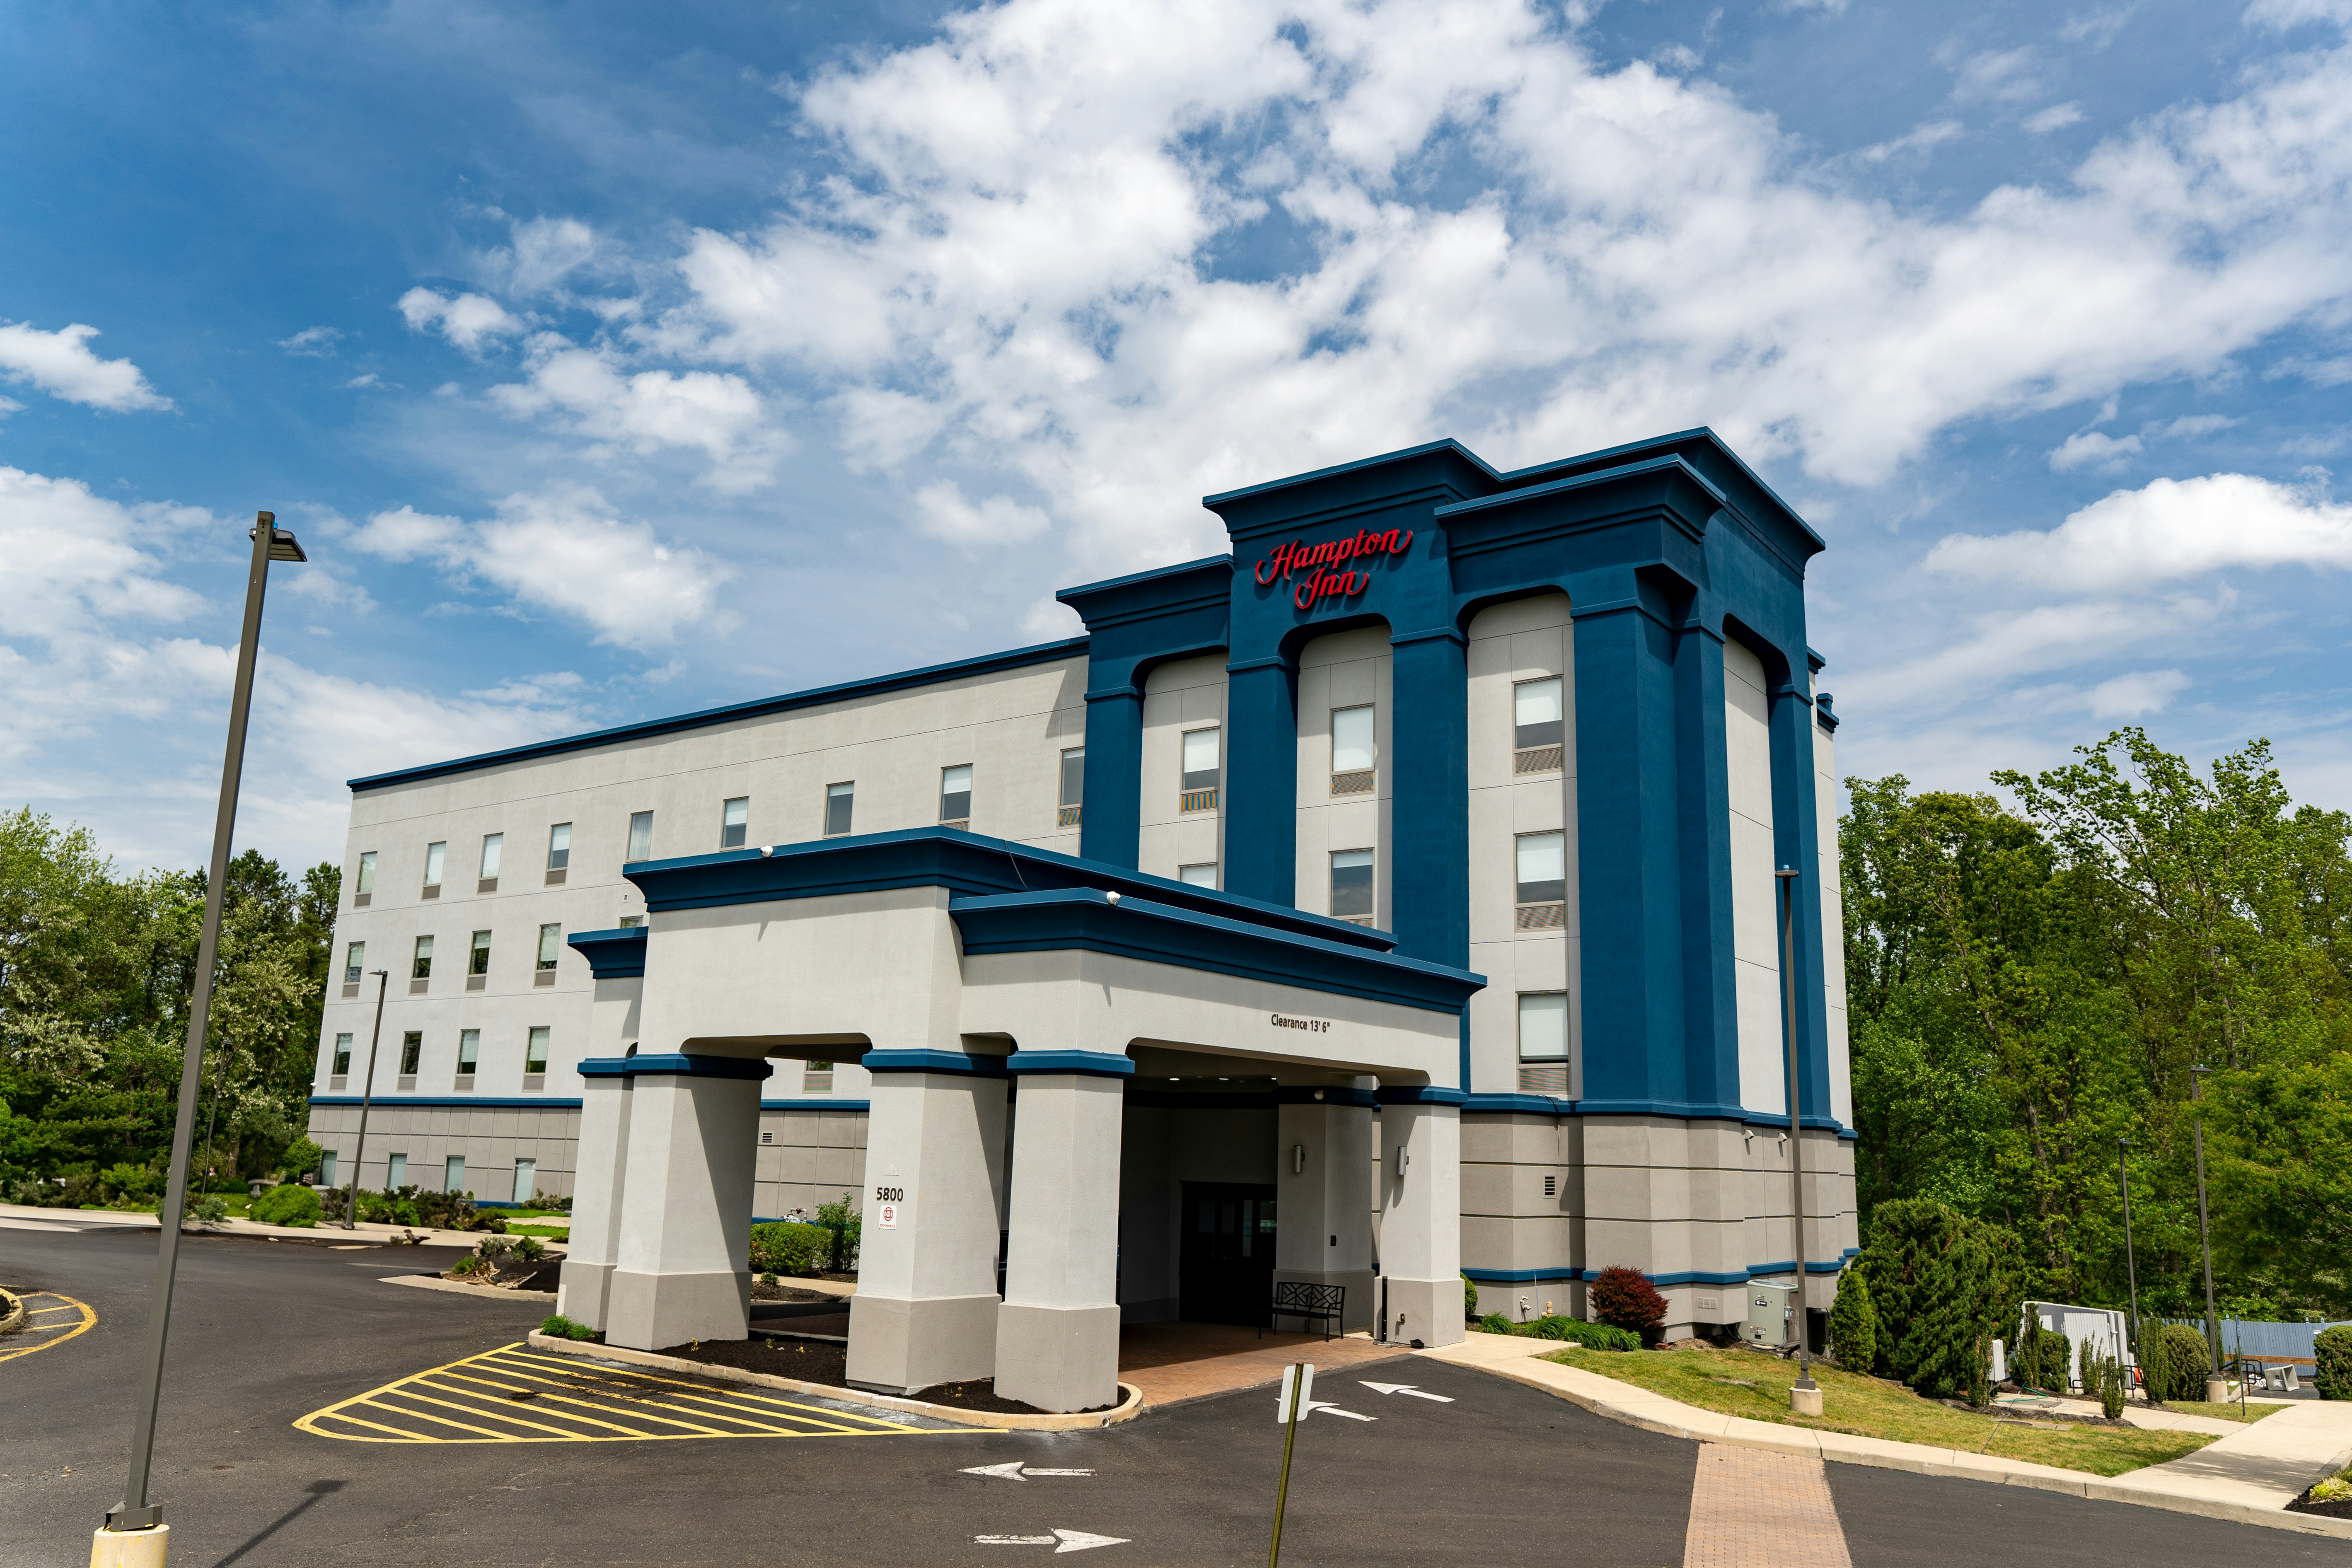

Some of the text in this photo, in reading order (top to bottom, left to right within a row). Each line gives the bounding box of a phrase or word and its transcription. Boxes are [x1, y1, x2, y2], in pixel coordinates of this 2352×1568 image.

[1255, 528, 1412, 585] Hampton
[1295, 567, 1369, 609] Inn
[1271, 1014, 1330, 1033] Clearance 13' 6"
[876, 1187, 903, 1201] 5800
